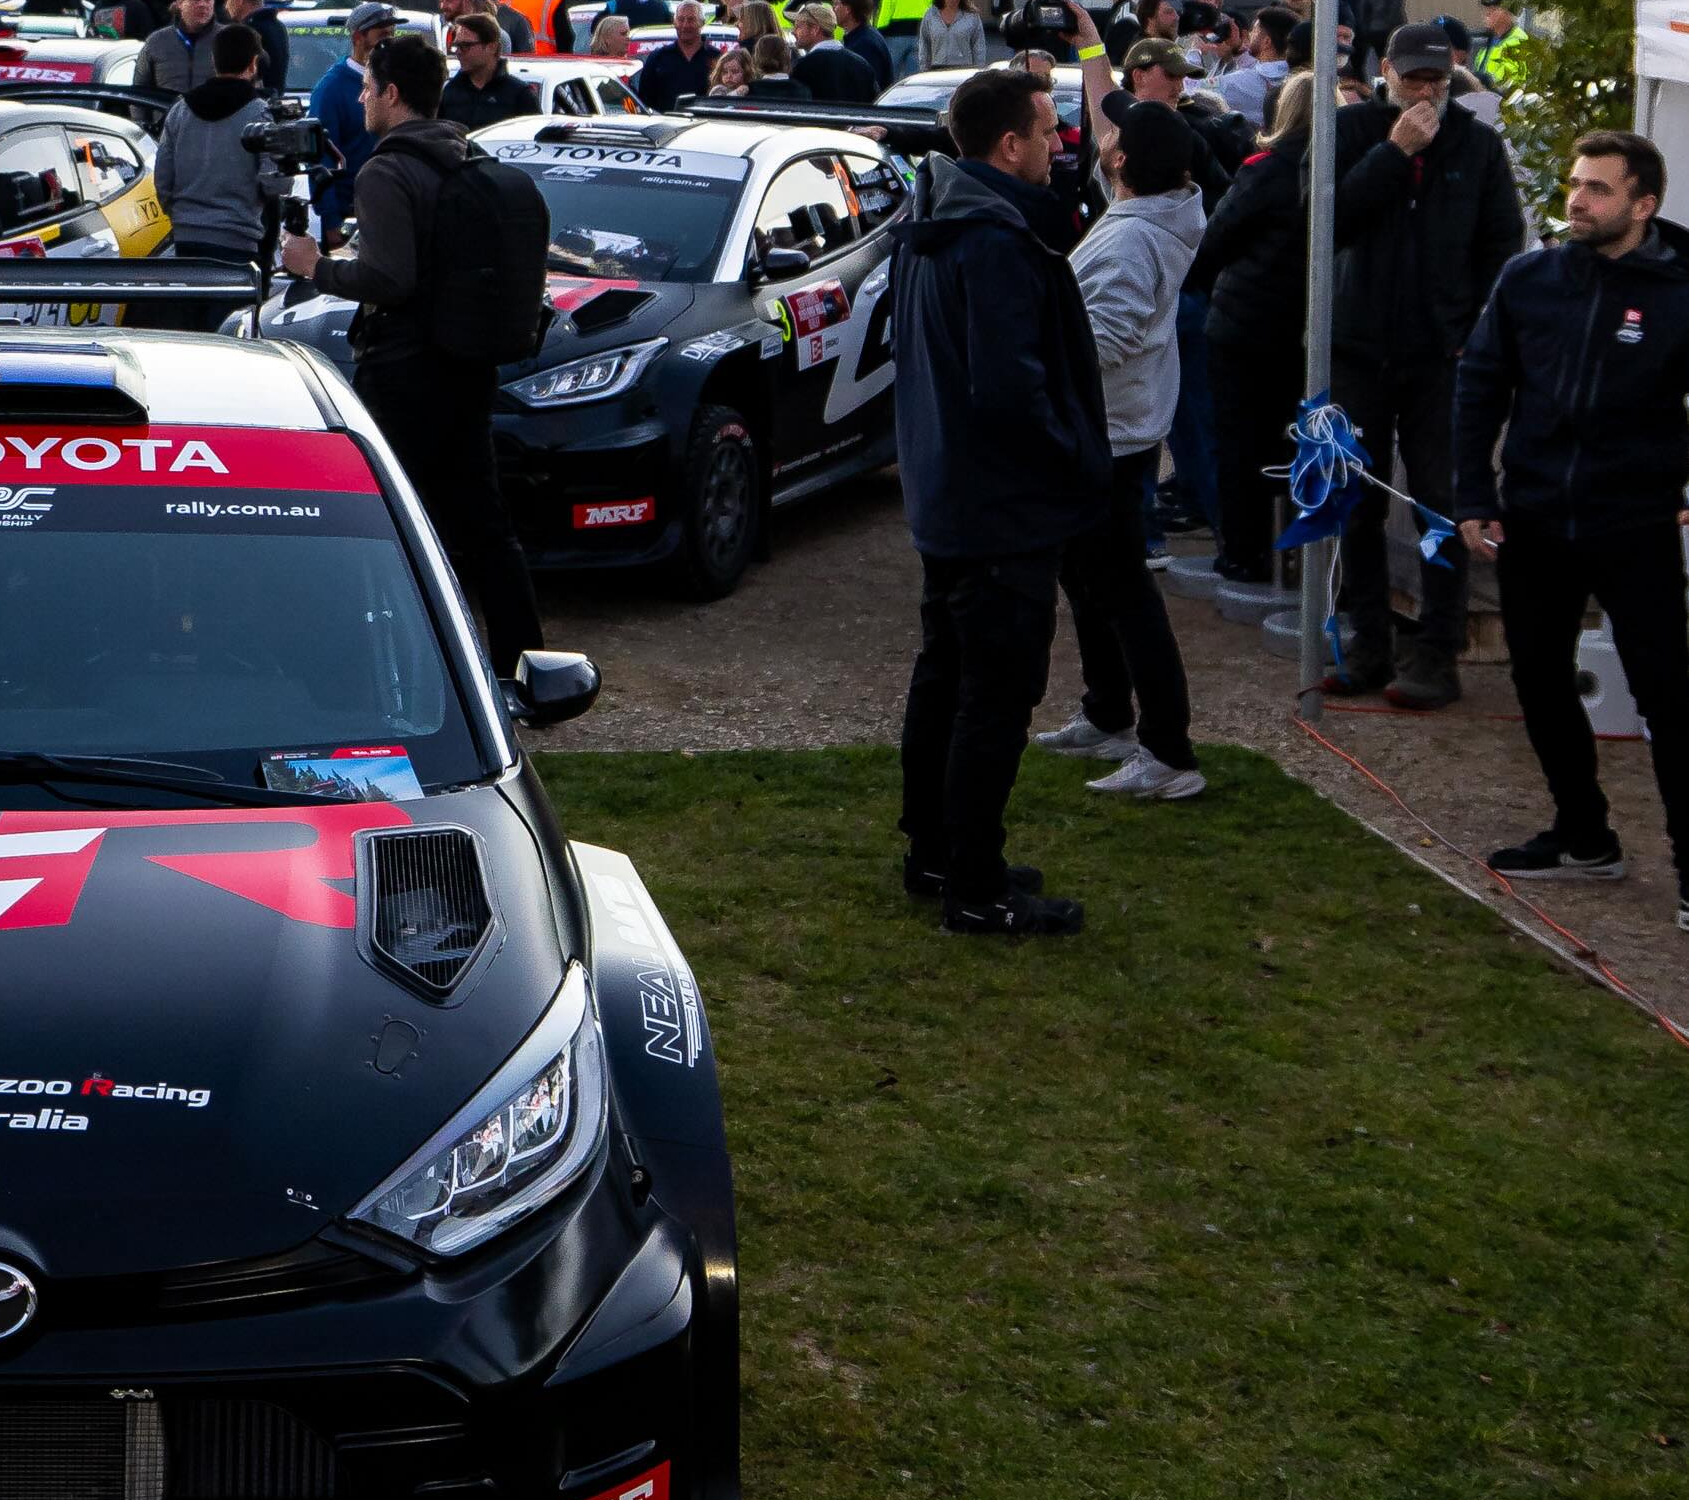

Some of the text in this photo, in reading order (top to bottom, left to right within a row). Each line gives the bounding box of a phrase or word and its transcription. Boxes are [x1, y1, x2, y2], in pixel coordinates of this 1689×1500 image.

[553, 146, 682, 169] TOYOTA
[641, 176, 711, 188] rally.com.au
[165, 501, 320, 517] rally.com.au
[584, 502, 648, 525] MRF
[80, 1078, 212, 1108] Racing
